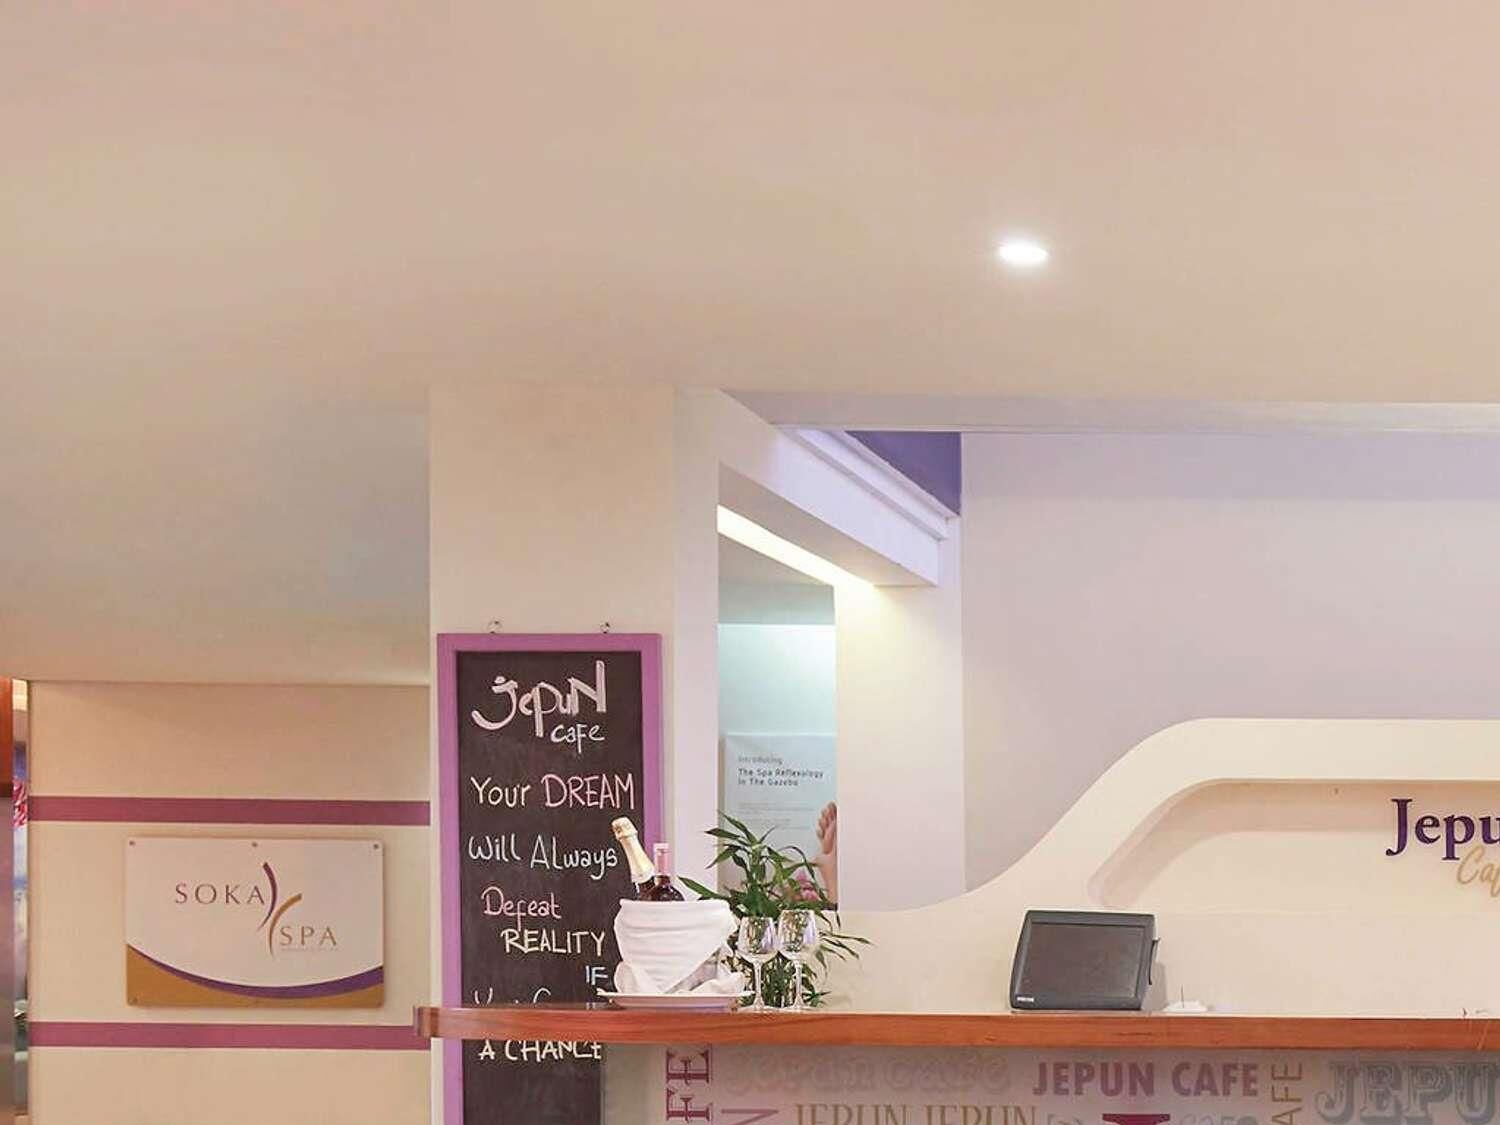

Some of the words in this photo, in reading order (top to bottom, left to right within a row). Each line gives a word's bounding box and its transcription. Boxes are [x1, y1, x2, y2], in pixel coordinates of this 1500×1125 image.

[738, 768, 754, 776] The
[757, 768, 772, 778] Spa
[775, 769, 824, 779] Reflexology
[749, 777, 764, 785] The
[768, 778, 799, 786] Gazebo
[470, 776, 531, 807] Your
[540, 773, 635, 810] DREAM
[468, 833, 522, 862] Will
[174, 882, 266, 905] SOKA
[481, 886, 562, 931] Defeat
[279, 925, 338, 947] SPA
[500, 928, 605, 957] REALITY
[585, 965, 609, 986] IF
[1033, 1061, 1155, 1096] JEPUN
[1171, 1062, 1258, 1097] CAFE
